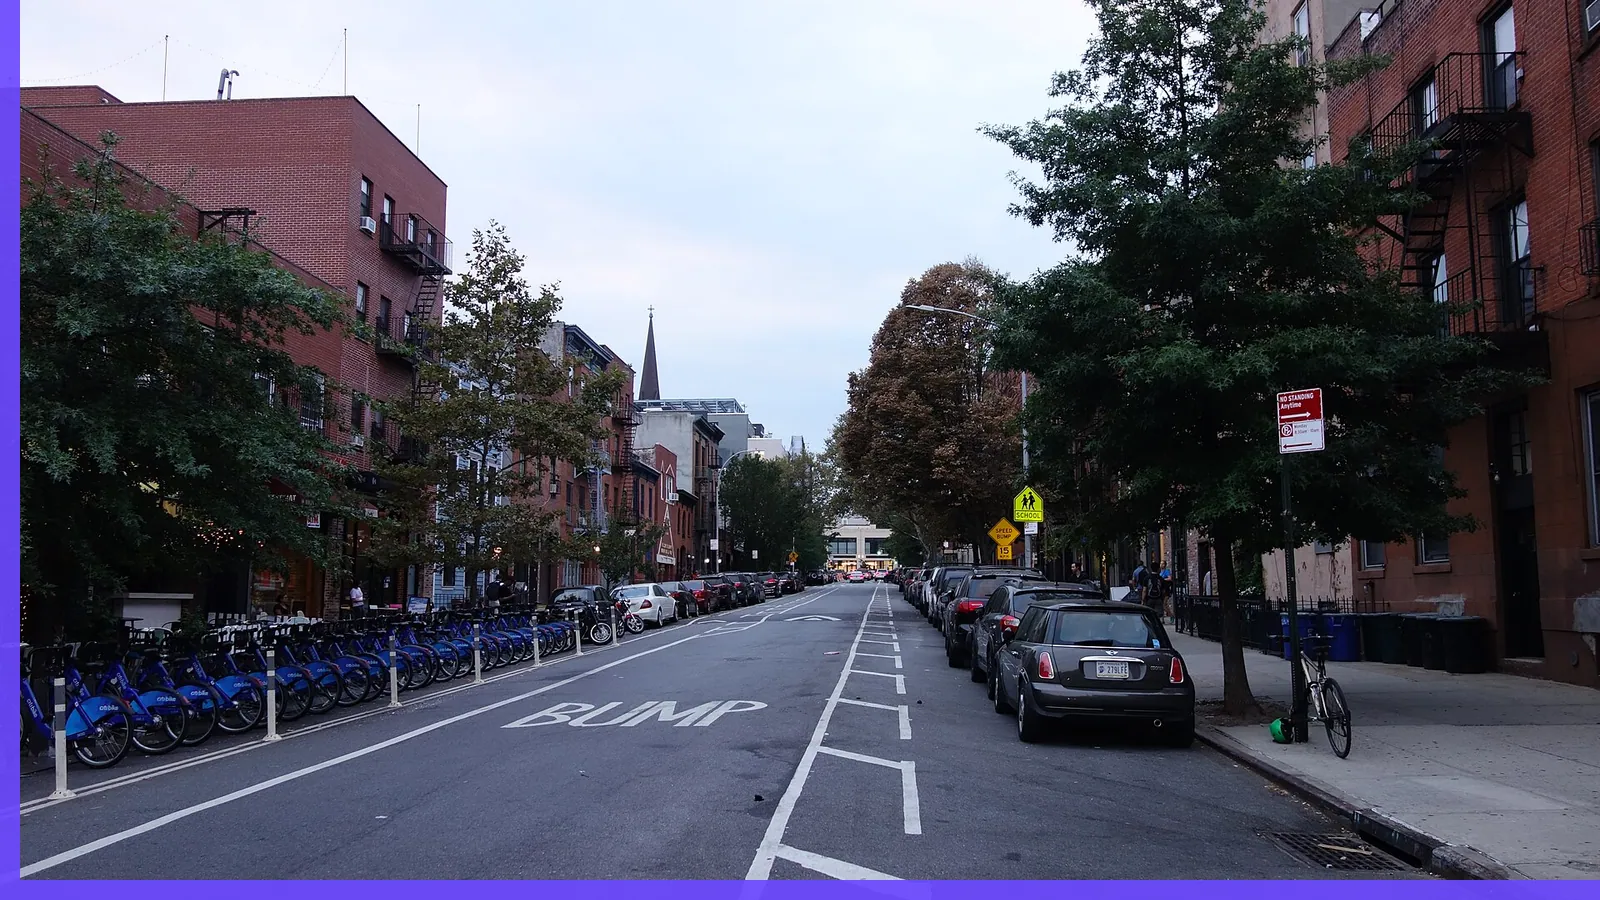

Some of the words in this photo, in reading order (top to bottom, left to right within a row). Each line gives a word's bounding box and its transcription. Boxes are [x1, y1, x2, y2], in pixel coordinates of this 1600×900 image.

[1288, 393, 1314, 401] STANDING
[1280, 402, 1302, 410] Anytime
[500, 700, 768, 728] BUMP
